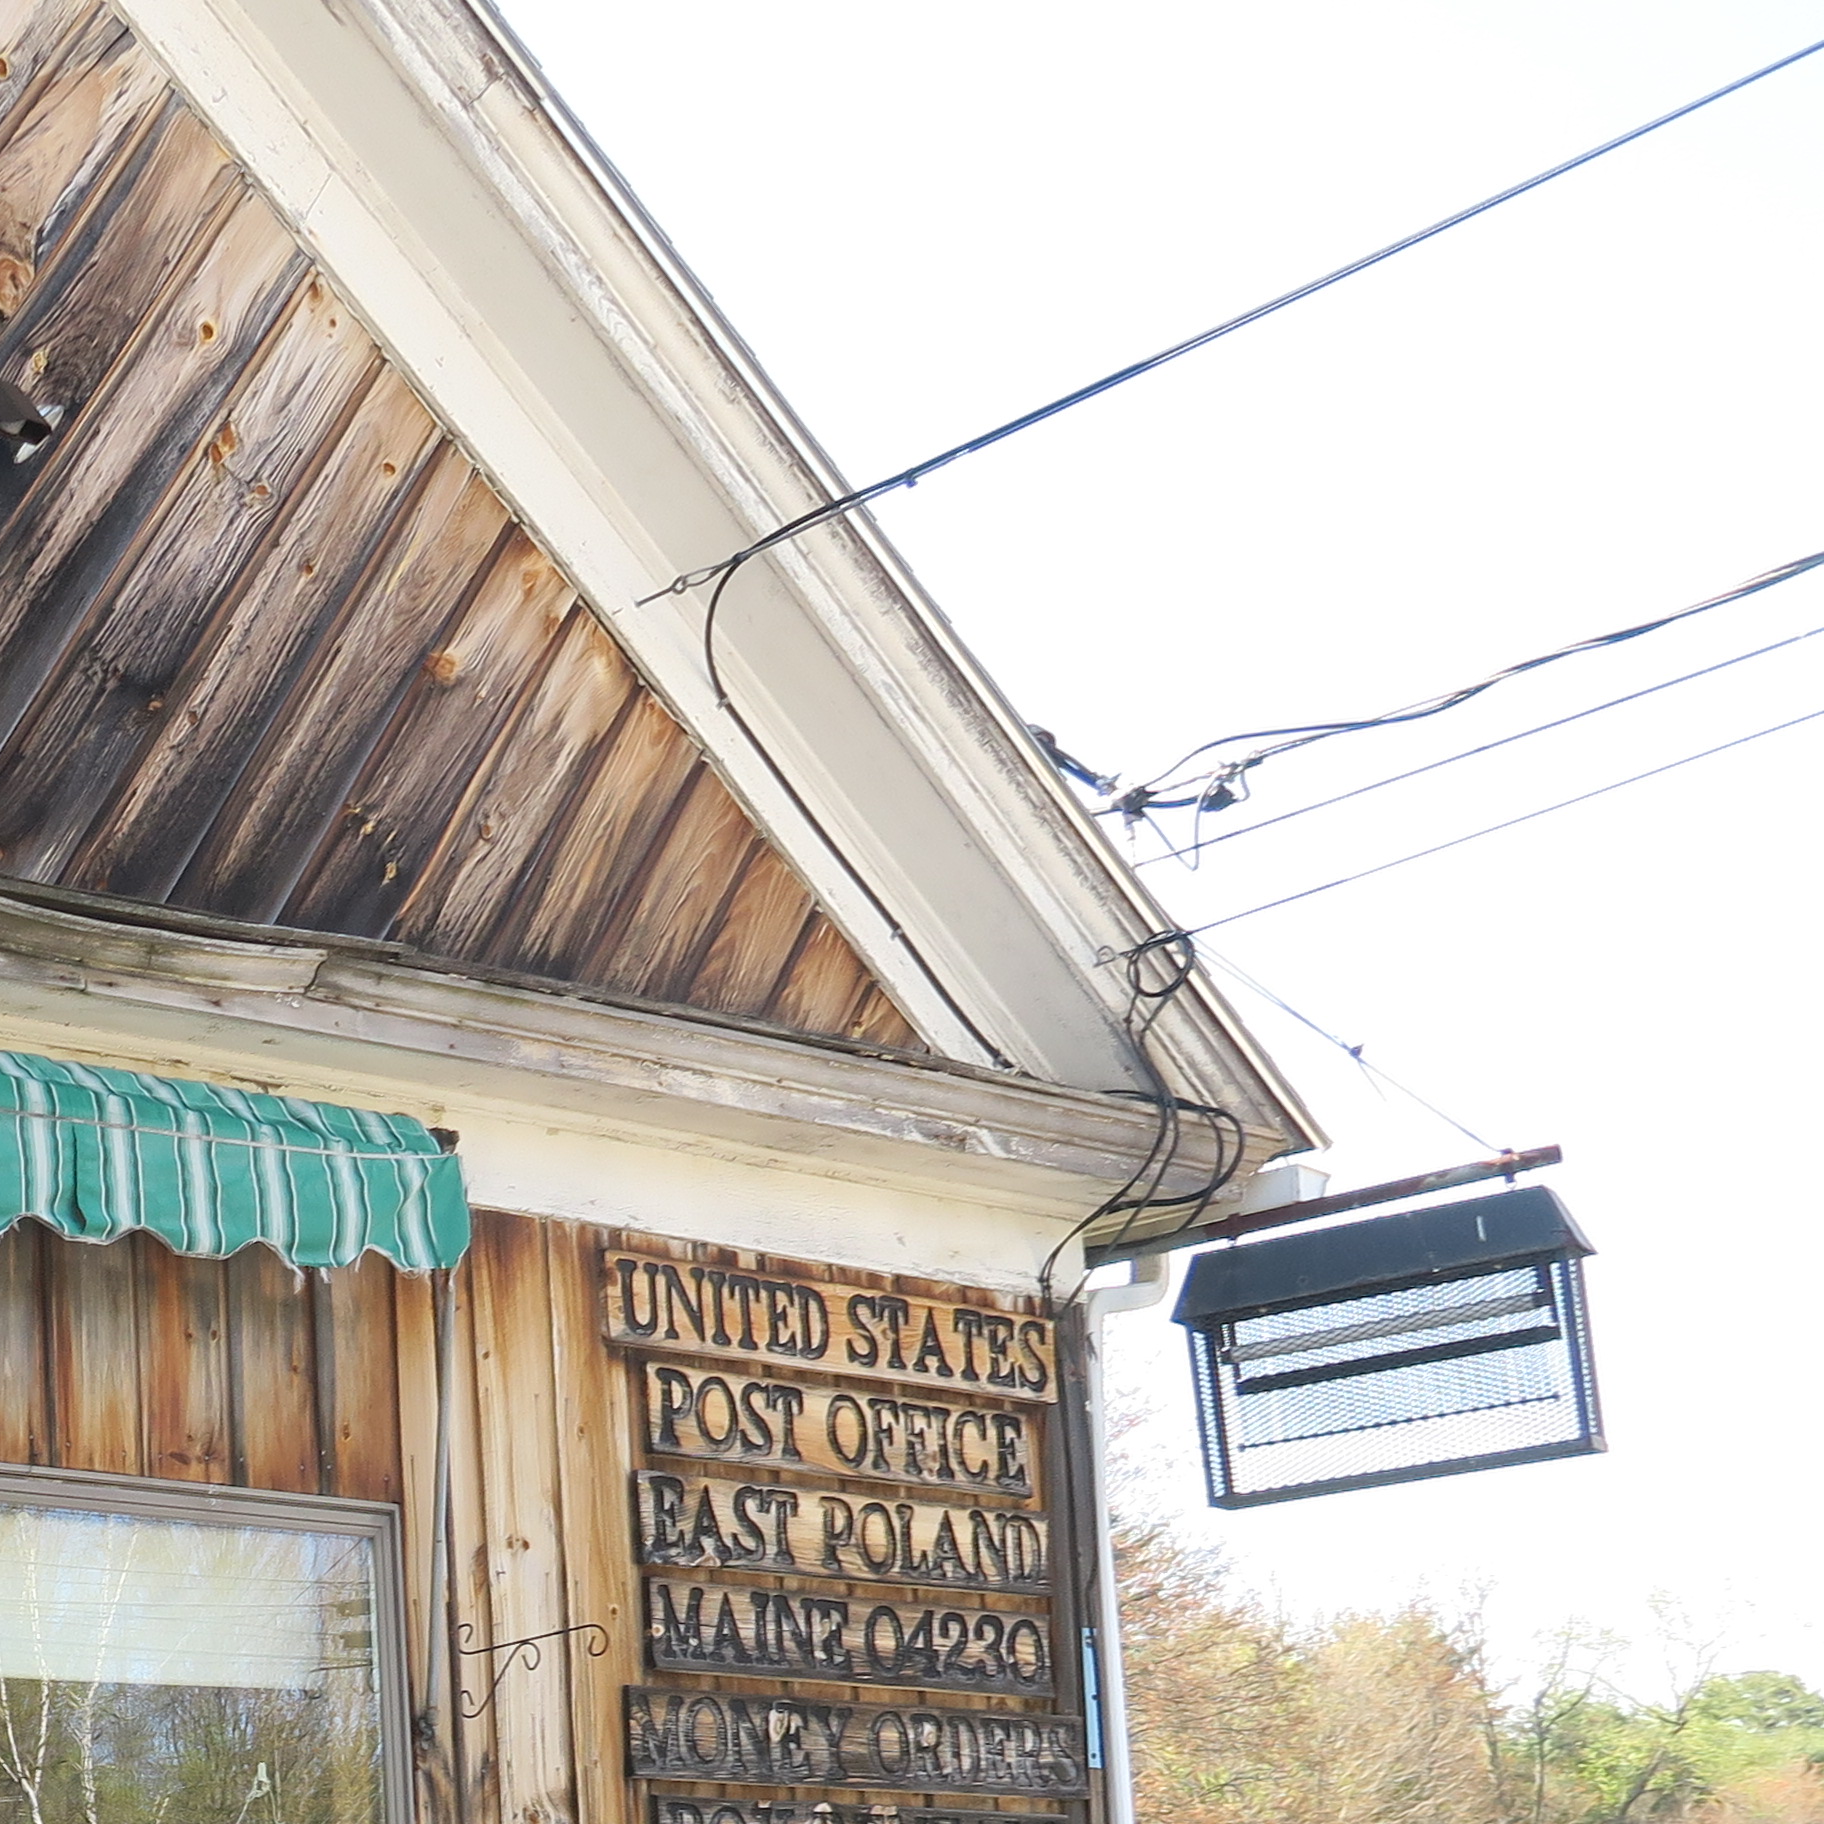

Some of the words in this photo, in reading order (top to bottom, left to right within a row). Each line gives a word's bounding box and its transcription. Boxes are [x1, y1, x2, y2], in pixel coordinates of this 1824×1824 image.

[614, 1258, 830, 1361] UNITED
[845, 1293, 1050, 1394] STATES
[654, 1366, 803, 1462] POST
[826, 1393, 1027, 1488] OFFICE
[648, 1475, 798, 1568] EAST
[819, 1494, 1046, 1584] POLAND
[657, 1584, 850, 1670] MAINE
[863, 1605, 1047, 1688] 04230
[631, 1693, 851, 1781] MONEY
[869, 1710, 1081, 1789] ORDERS
